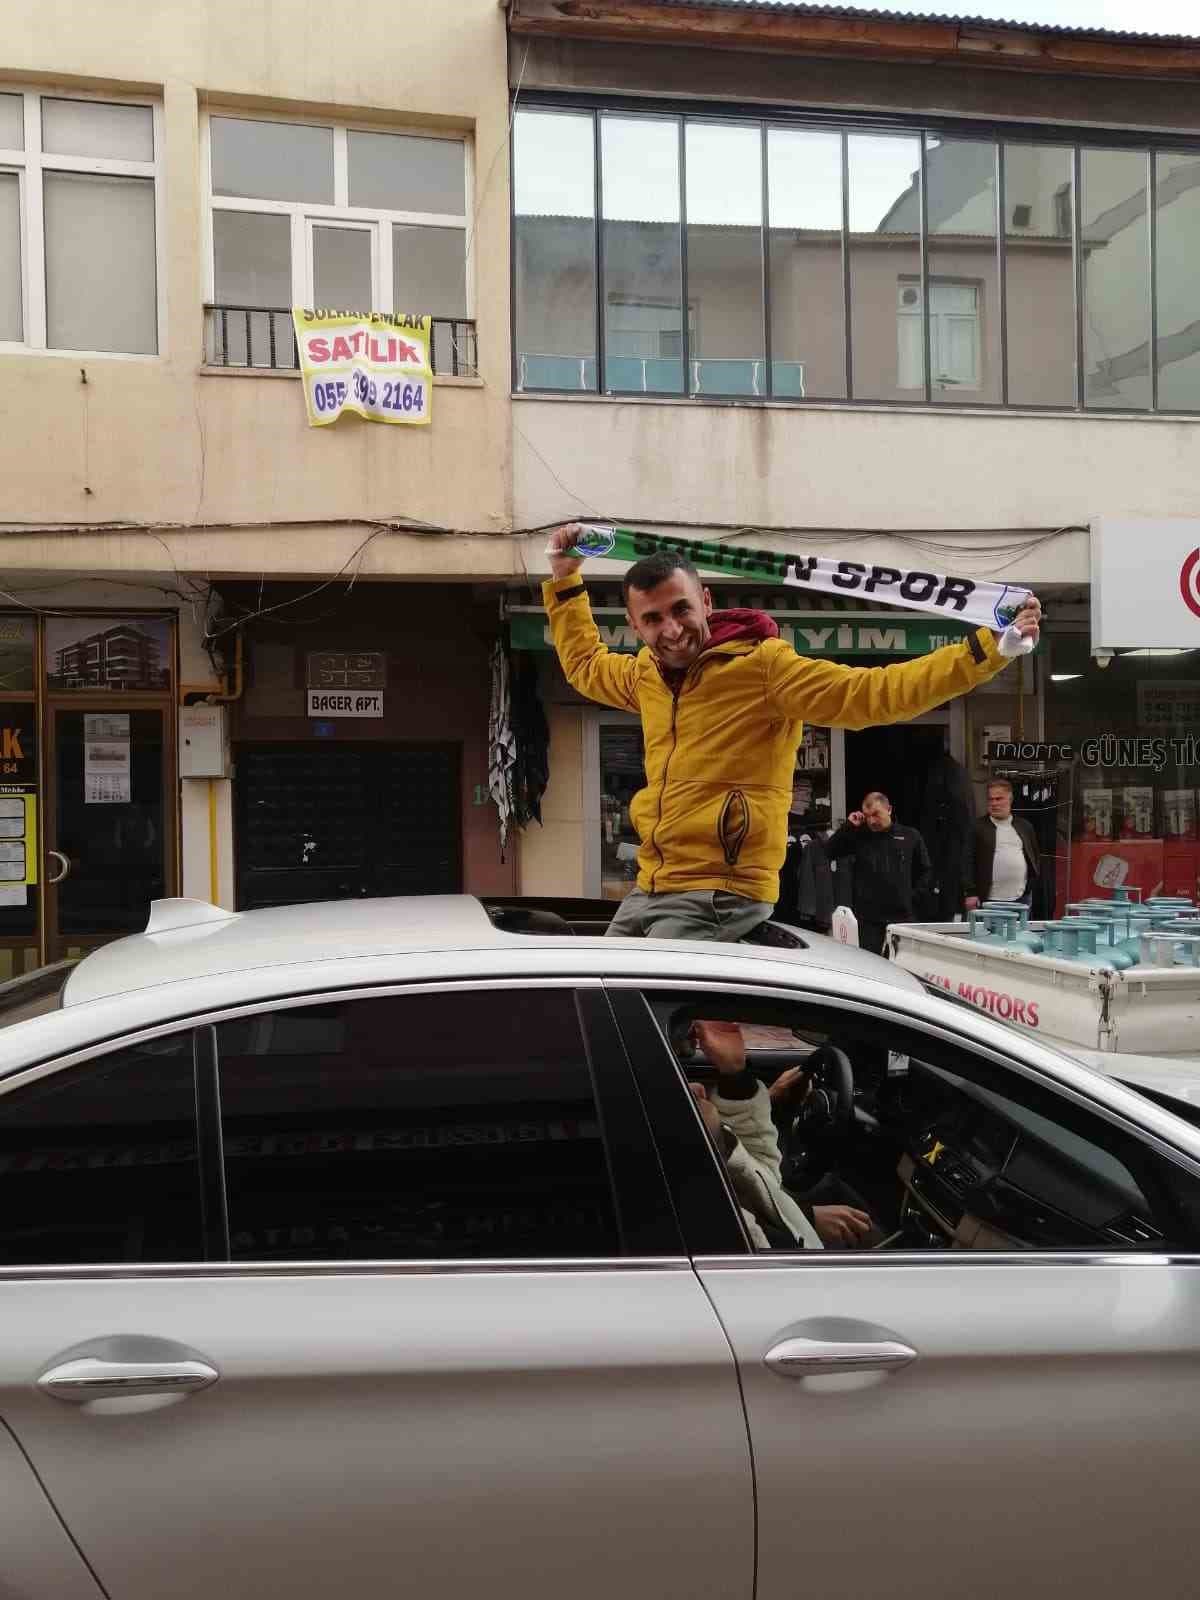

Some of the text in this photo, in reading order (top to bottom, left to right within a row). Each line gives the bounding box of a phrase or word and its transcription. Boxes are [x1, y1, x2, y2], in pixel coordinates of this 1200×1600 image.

[308, 330, 421, 363] SATILIK
[382, 381, 424, 412] 2164
[831, 561, 976, 612] SPOR
[780, 623, 907, 649] İYİM
[312, 695, 380, 712] BAGER APT.
[1080, 733, 1167, 772] GÜNEŞ
[958, 982, 1040, 1028] MOTORS
